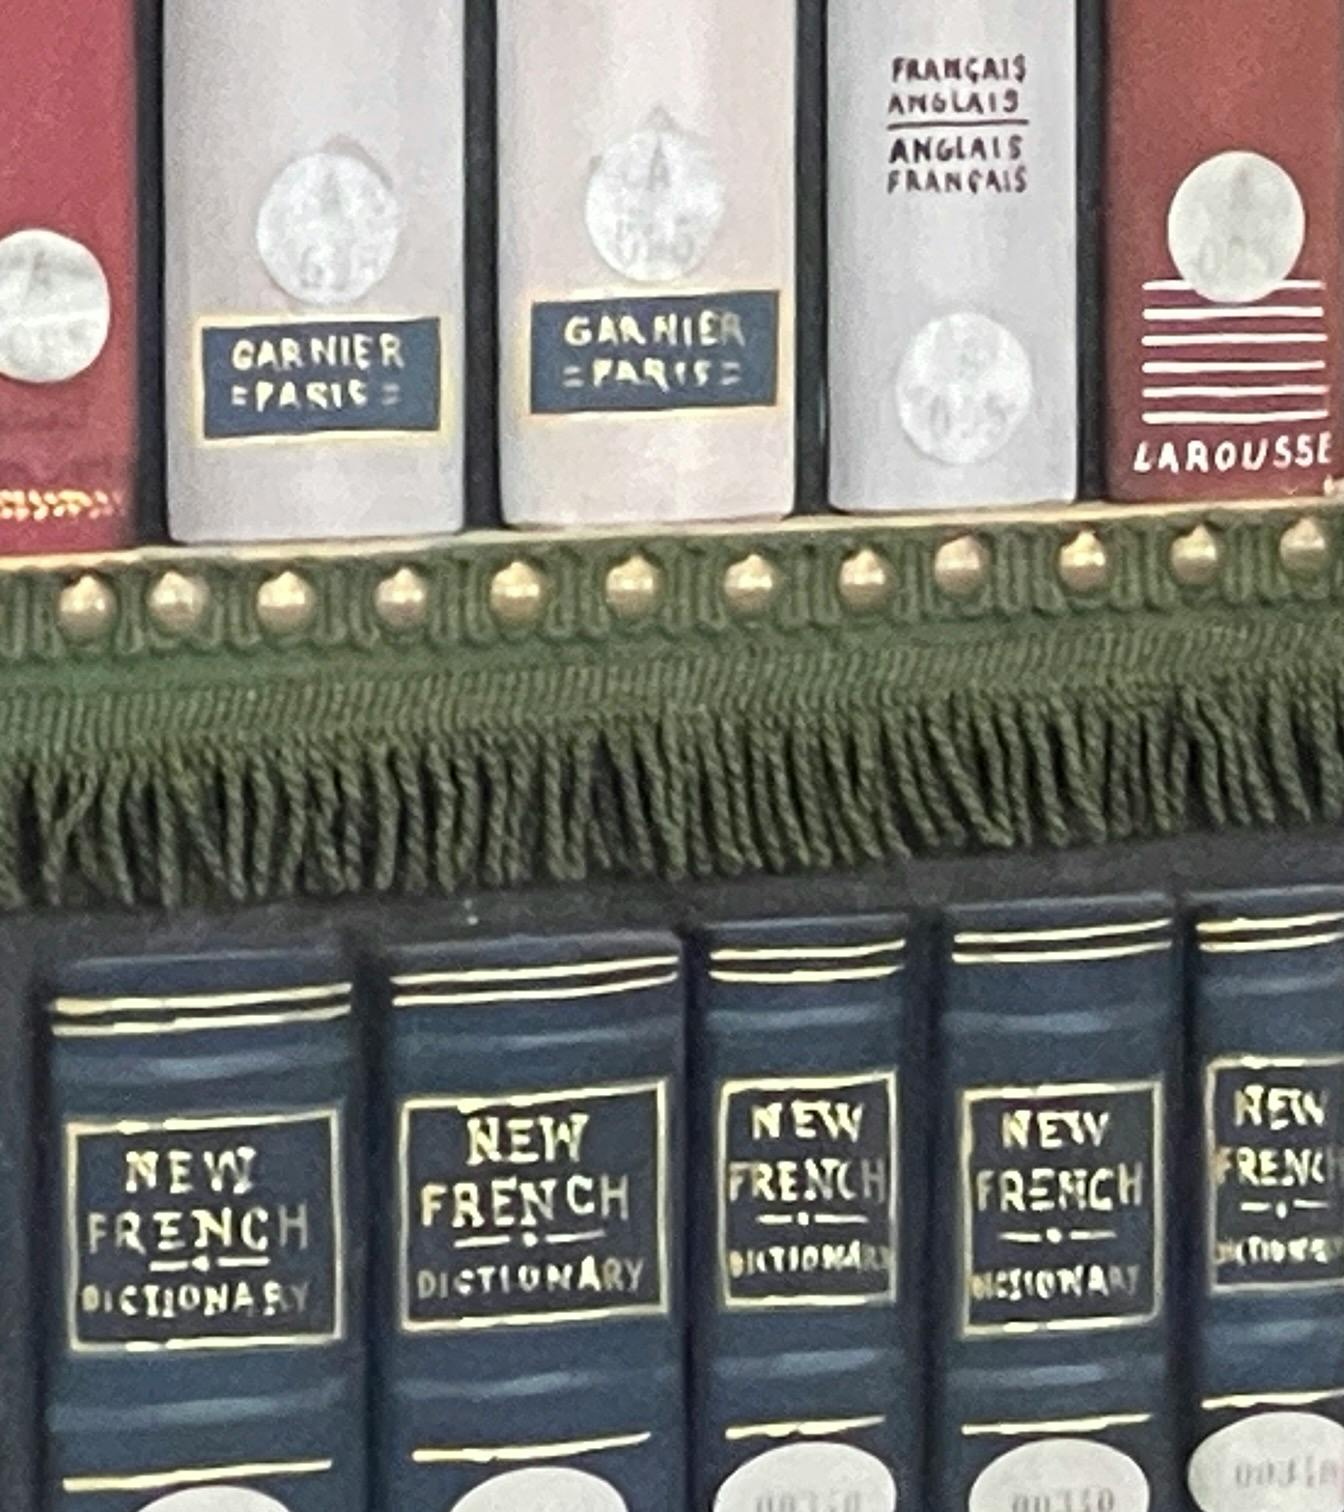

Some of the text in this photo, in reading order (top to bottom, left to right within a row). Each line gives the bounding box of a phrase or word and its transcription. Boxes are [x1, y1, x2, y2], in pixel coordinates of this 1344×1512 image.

[892, 54, 1027, 84] FRANÇAIS
[887, 92, 1019, 116] ANGLAIS
[888, 136, 1023, 164] ANGLAIS
[887, 166, 1027, 195] FRANÇAIS
[564, 310, 746, 348] GARNIER
[231, 332, 405, 371] GARNIER
[1133, 432, 1332, 474] LAROUSSE
[751, 1100, 864, 1143] NEW
[1234, 1083, 1327, 1131] NEW
[466, 1113, 591, 1167] NEW
[1001, 1109, 1110, 1149] NEW
[125, 1146, 258, 1194] NEW
[728, 1157, 888, 1202] FRENCH
[976, 1162, 1145, 1212] FRENCH
[420, 1174, 631, 1229] FRENCH
[86, 1204, 310, 1256] FRENCH
[417, 1256, 646, 1300] DICTIONARY
[81, 1280, 312, 1319] DICTIONARY
